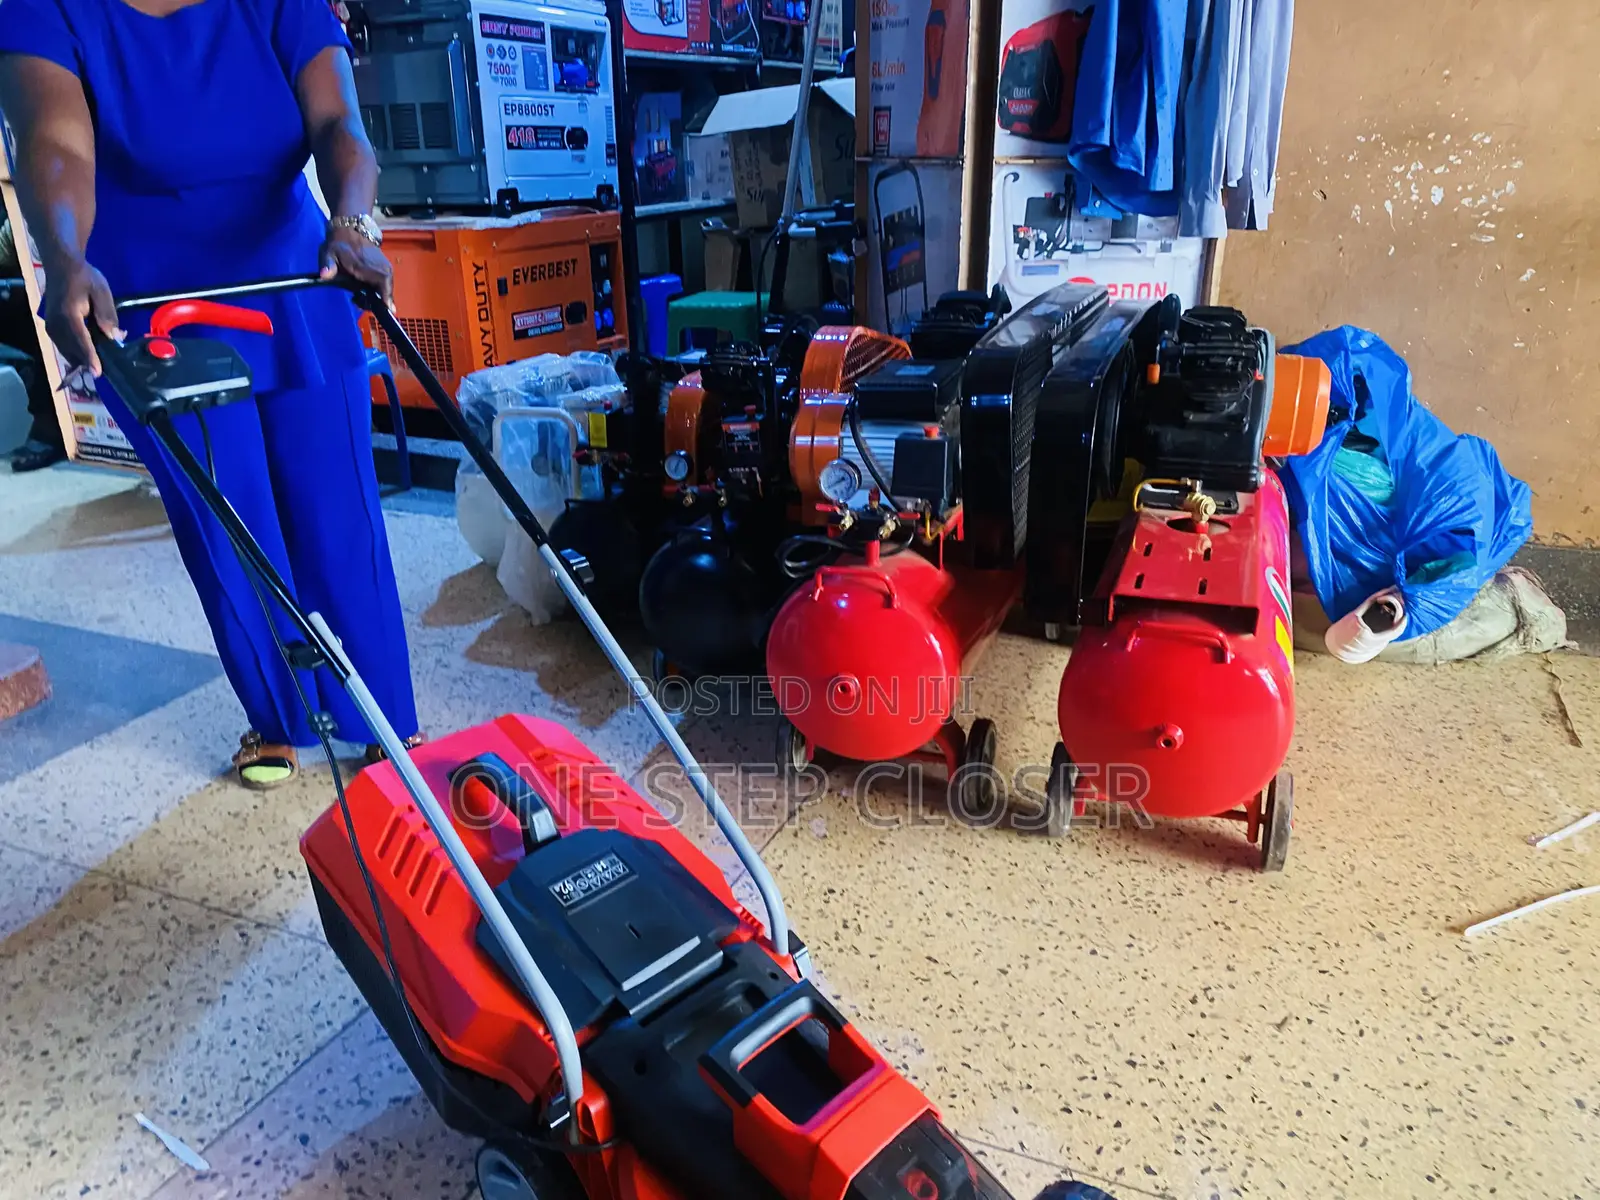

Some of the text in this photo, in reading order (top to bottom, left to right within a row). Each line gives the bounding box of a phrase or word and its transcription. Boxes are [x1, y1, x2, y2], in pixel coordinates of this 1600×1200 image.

[503, 103, 555, 117] EP8800ST
[512, 258, 579, 285] EVERBEST
[472, 262, 489, 322] DUTY
